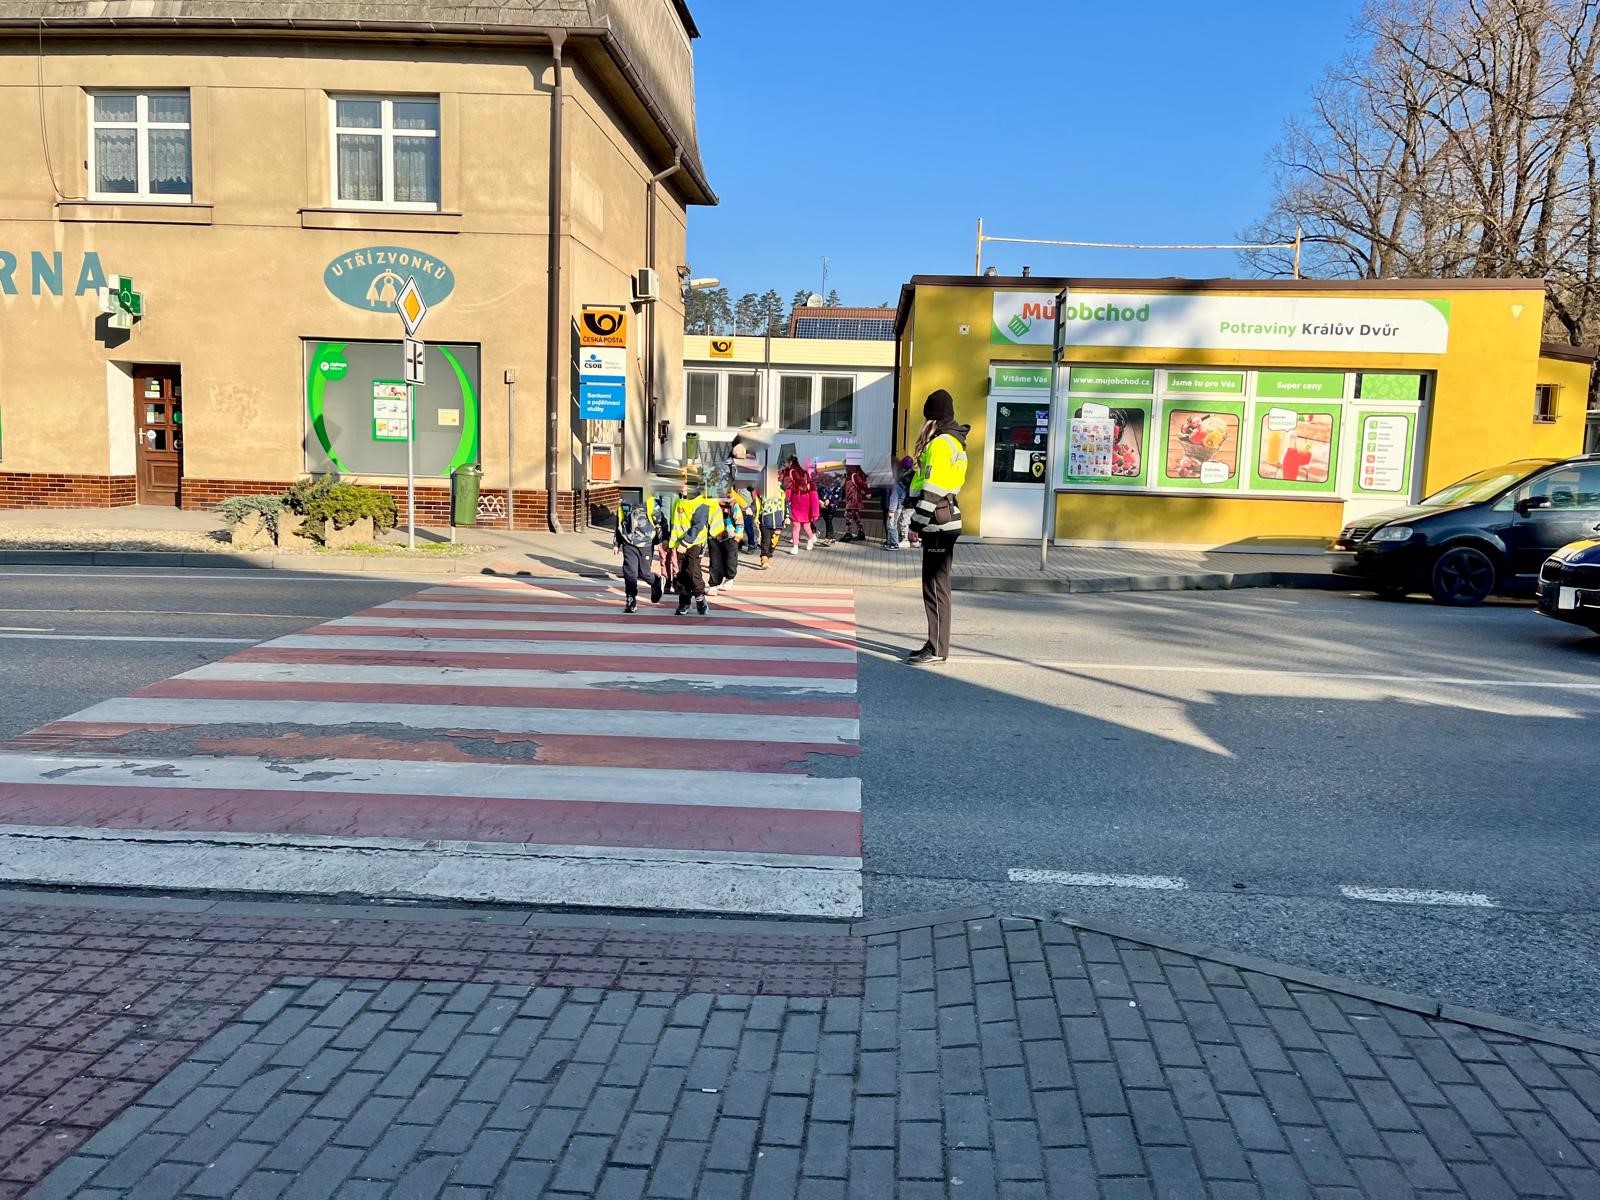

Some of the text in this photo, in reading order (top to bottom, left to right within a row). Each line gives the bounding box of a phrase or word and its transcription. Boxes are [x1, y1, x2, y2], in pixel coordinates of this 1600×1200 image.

[1022, 299, 1058, 320] Mů
[1219, 321, 1400, 337] Potraviny Králův Dvůr
[582, 335, 624, 344] ČESKÁ POŠTA
[1072, 377, 1150, 386] www.mujobchod.cz
[1171, 379, 1193, 387] Jsme
[1204, 381, 1219, 389] pro
[1276, 381, 1323, 392] Super ceny
